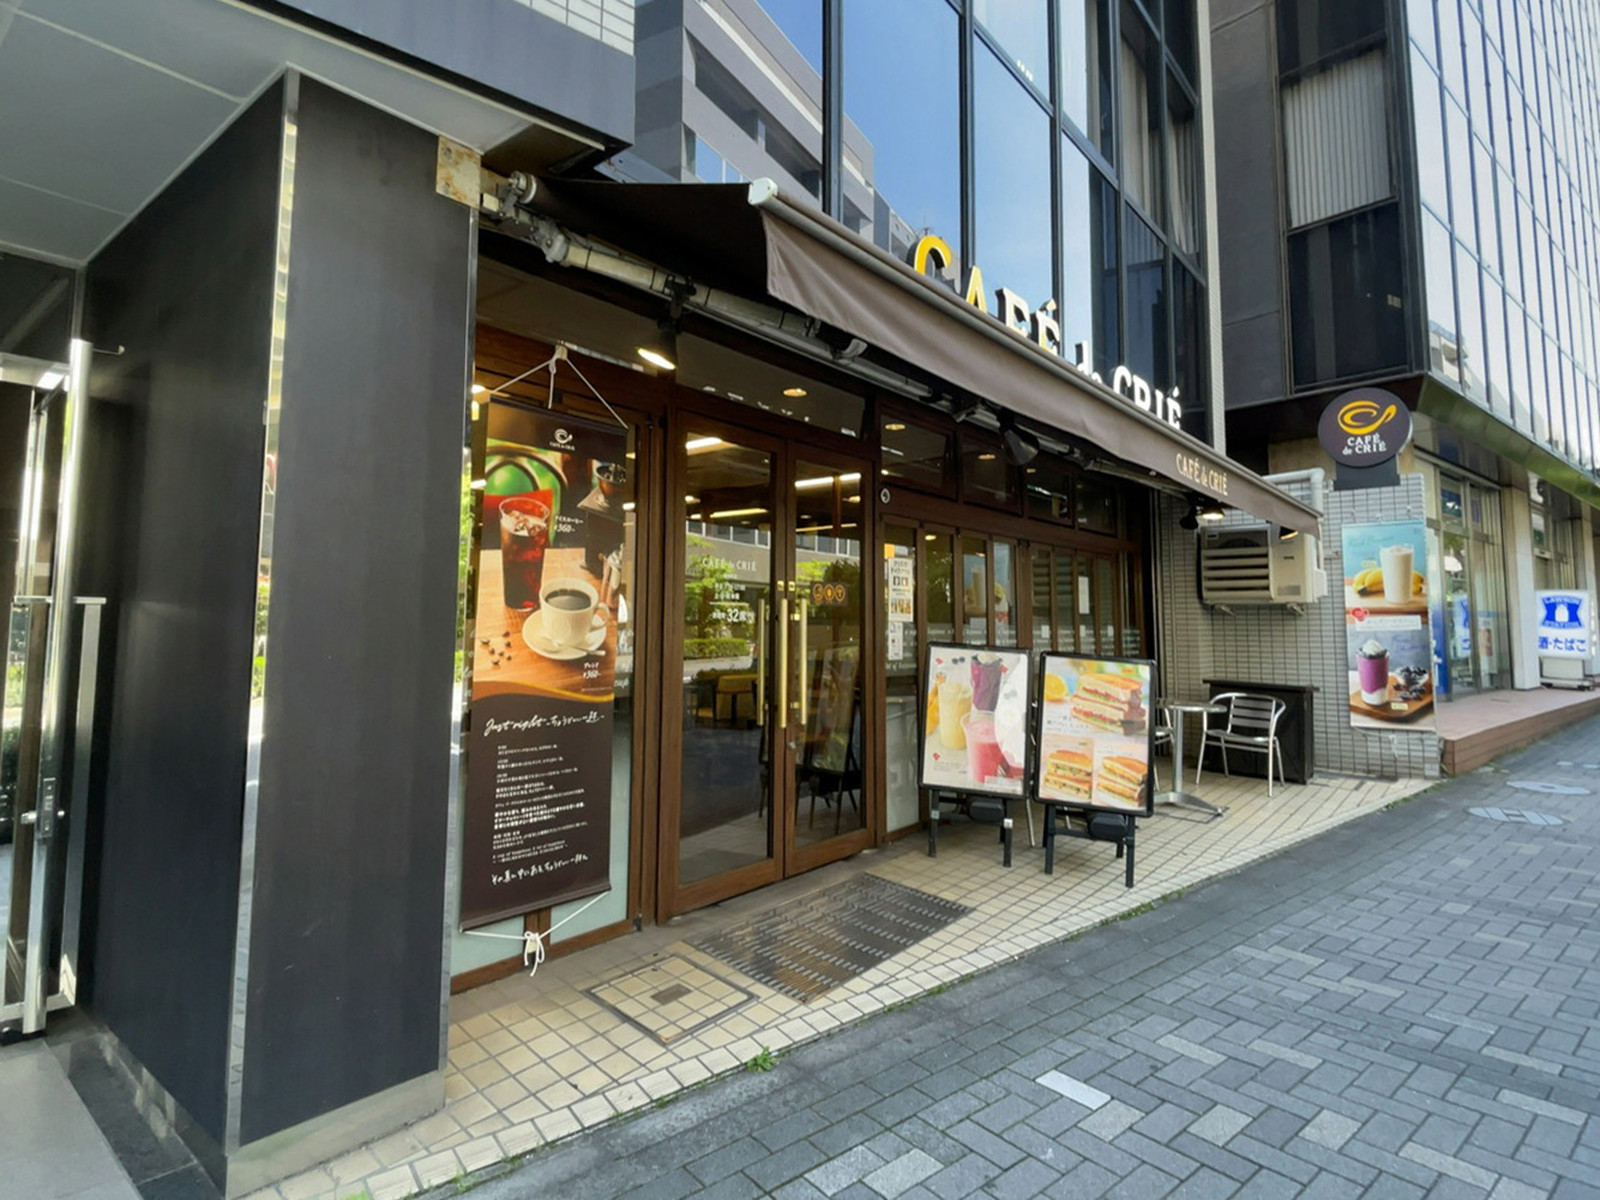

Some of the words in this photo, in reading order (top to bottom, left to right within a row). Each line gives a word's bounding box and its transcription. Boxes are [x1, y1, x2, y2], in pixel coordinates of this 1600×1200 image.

[1342, 446, 1353, 456] de
[1355, 441, 1387, 454] CRIÉ
[1346, 432, 1382, 447] CAFÉ
[1175, 452, 1201, 484] CAFÉ
[1208, 469, 1229, 497] CRIÉ
[483, 718, 513, 737] Just
[513, 714, 546, 731] right
